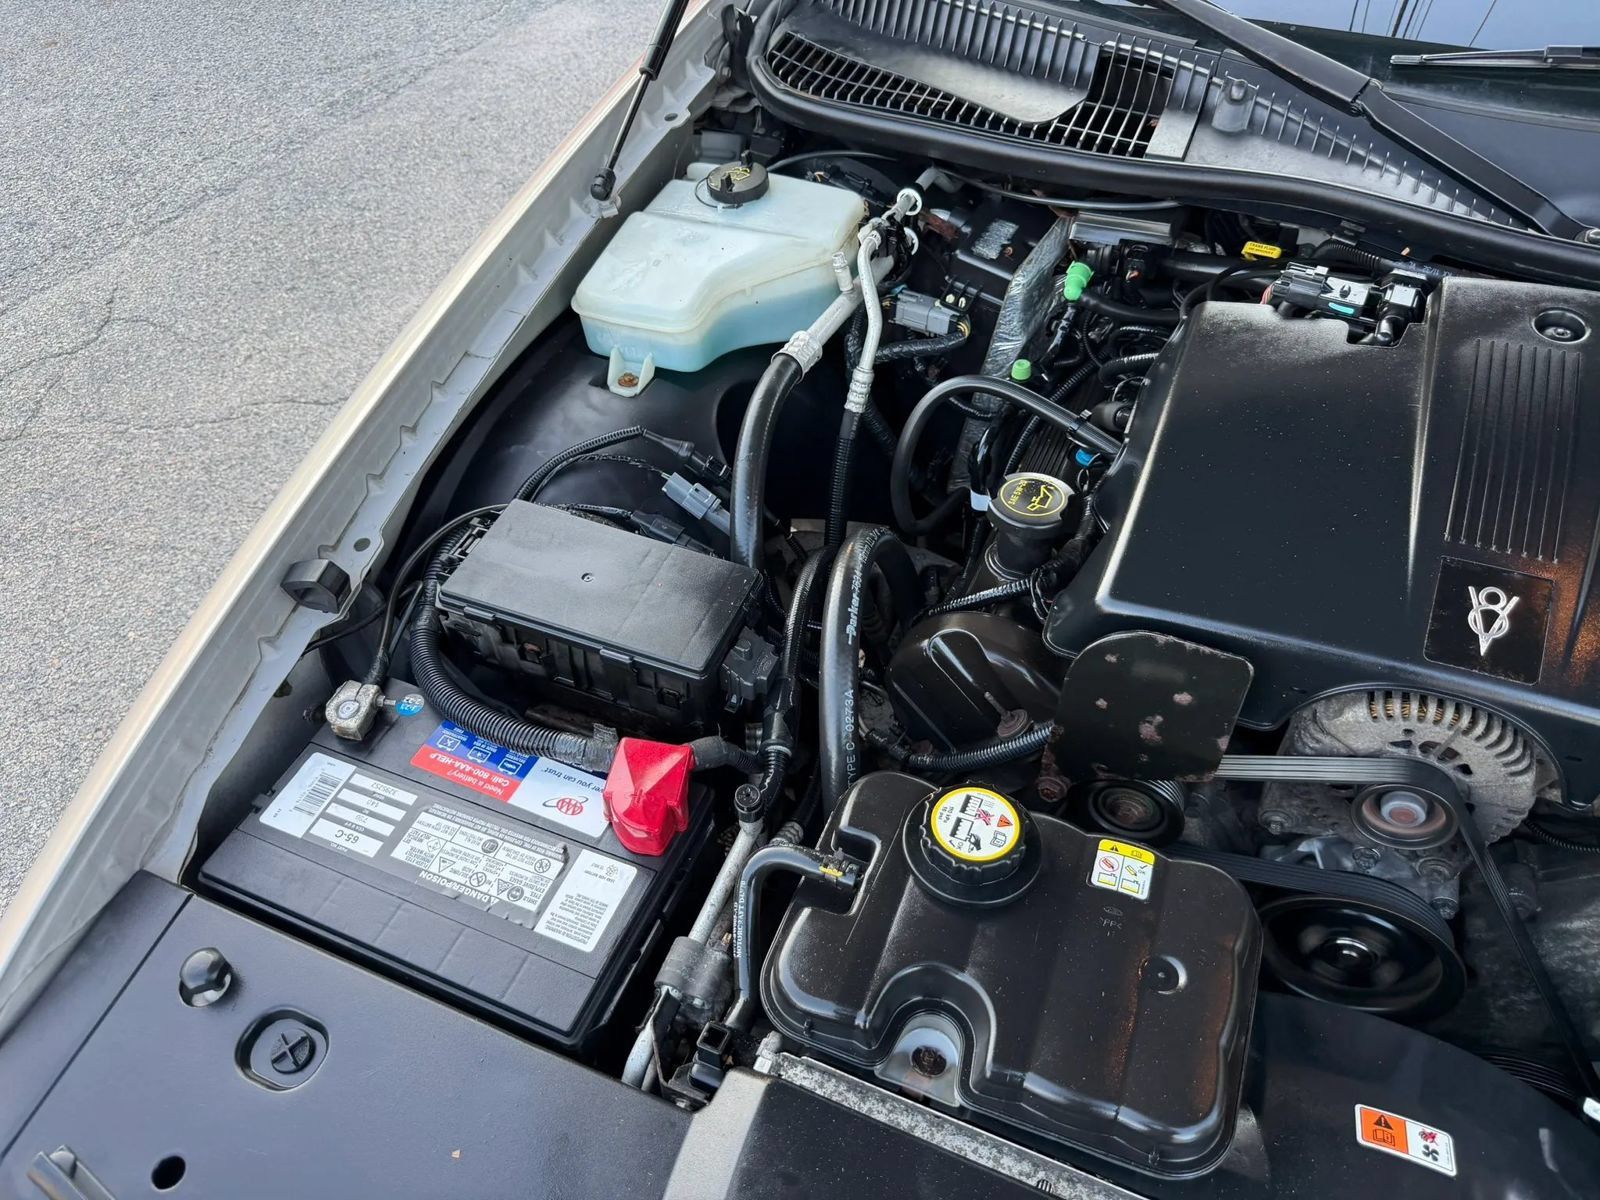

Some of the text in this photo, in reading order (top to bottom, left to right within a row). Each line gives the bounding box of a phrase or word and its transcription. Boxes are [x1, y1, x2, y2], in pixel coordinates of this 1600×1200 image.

[1007, 494, 1018, 505] SAE
[844, 688, 855, 733] 0273A
[846, 741, 855, 753] C
[429, 751, 510, 786] Call: 800-AAA-HELP
[446, 768, 478, 784] battery?
[544, 766, 563, 778] trust
[563, 773, 576, 783] can
[577, 779, 594, 790] you
[483, 782, 503, 795] Need
[557, 797, 583, 815] AAA
[334, 828, 359, 844] 65-C
[418, 870, 490, 902] DANGER/POISON
[736, 904, 744, 957] MOTORCRAFT
